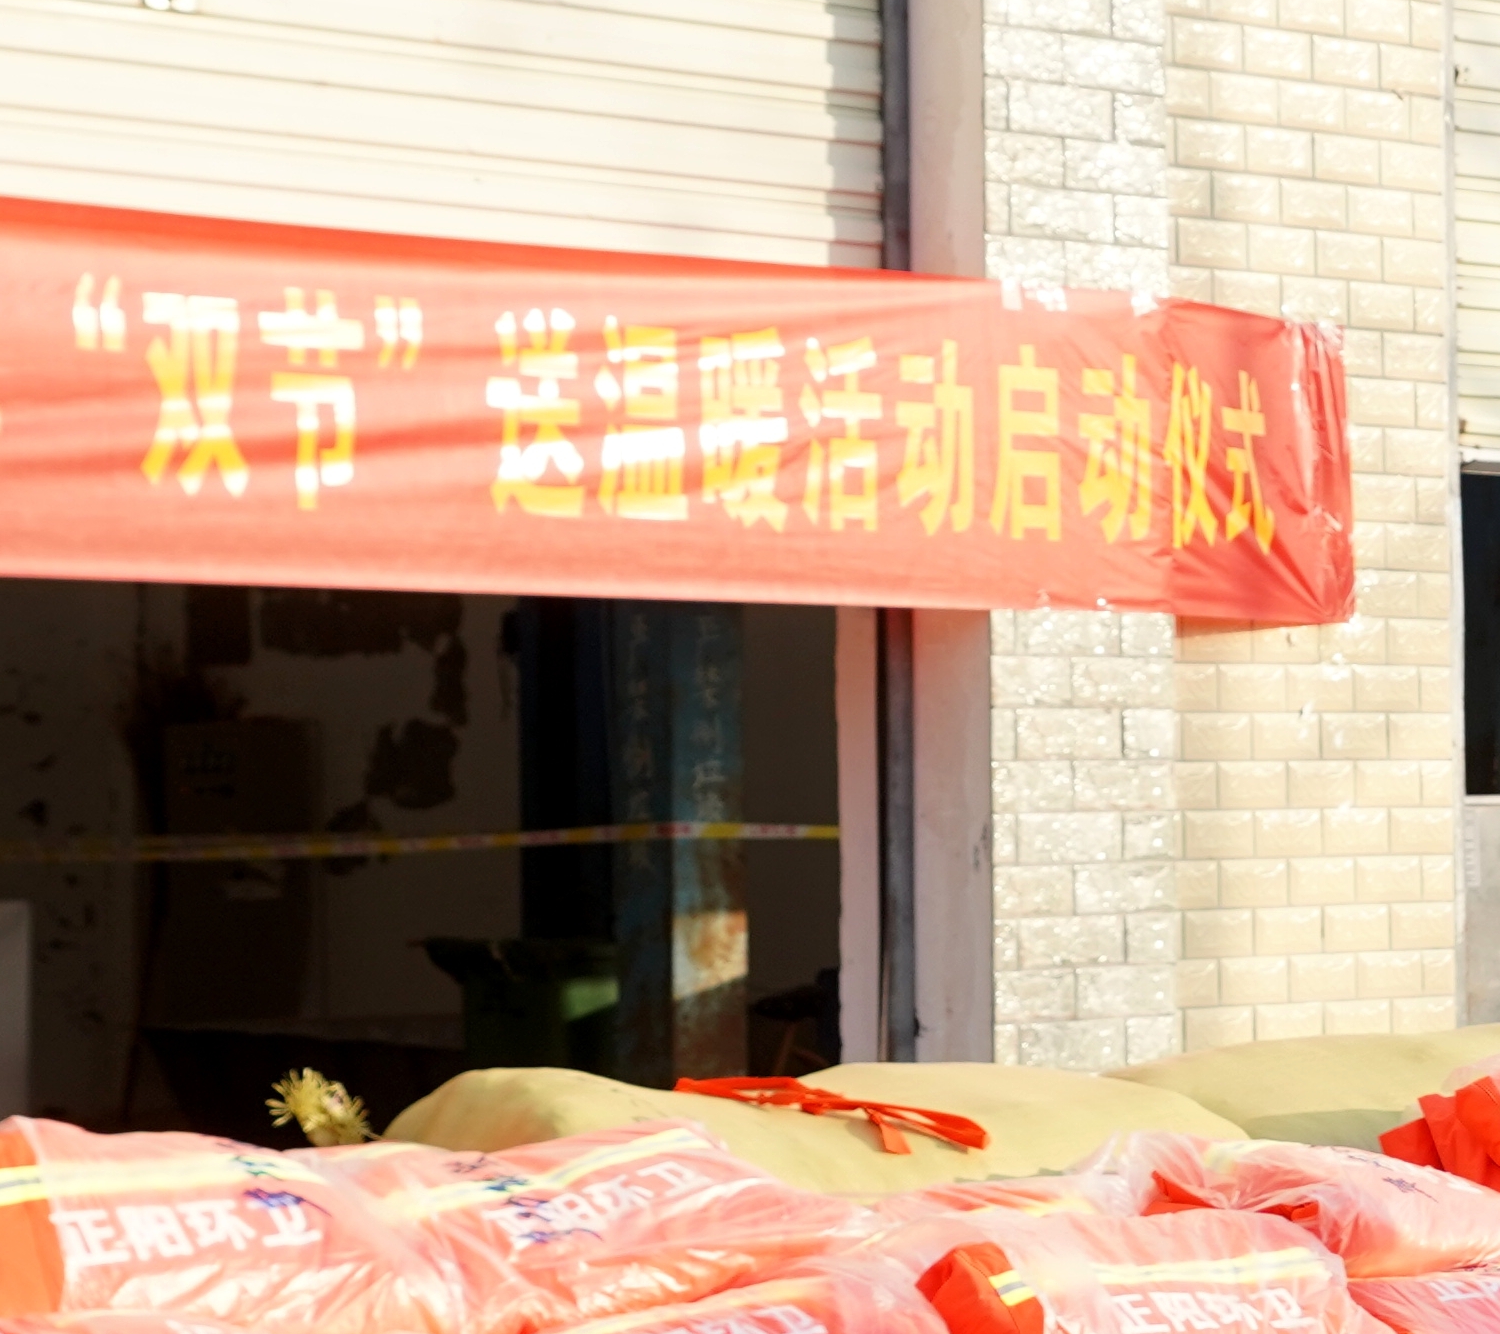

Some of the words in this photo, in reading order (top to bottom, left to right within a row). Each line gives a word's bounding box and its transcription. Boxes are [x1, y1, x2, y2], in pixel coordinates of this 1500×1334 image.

[49, 1197, 322, 1267] 正阳环卫
[481, 1160, 713, 1250] 正阳环卫
